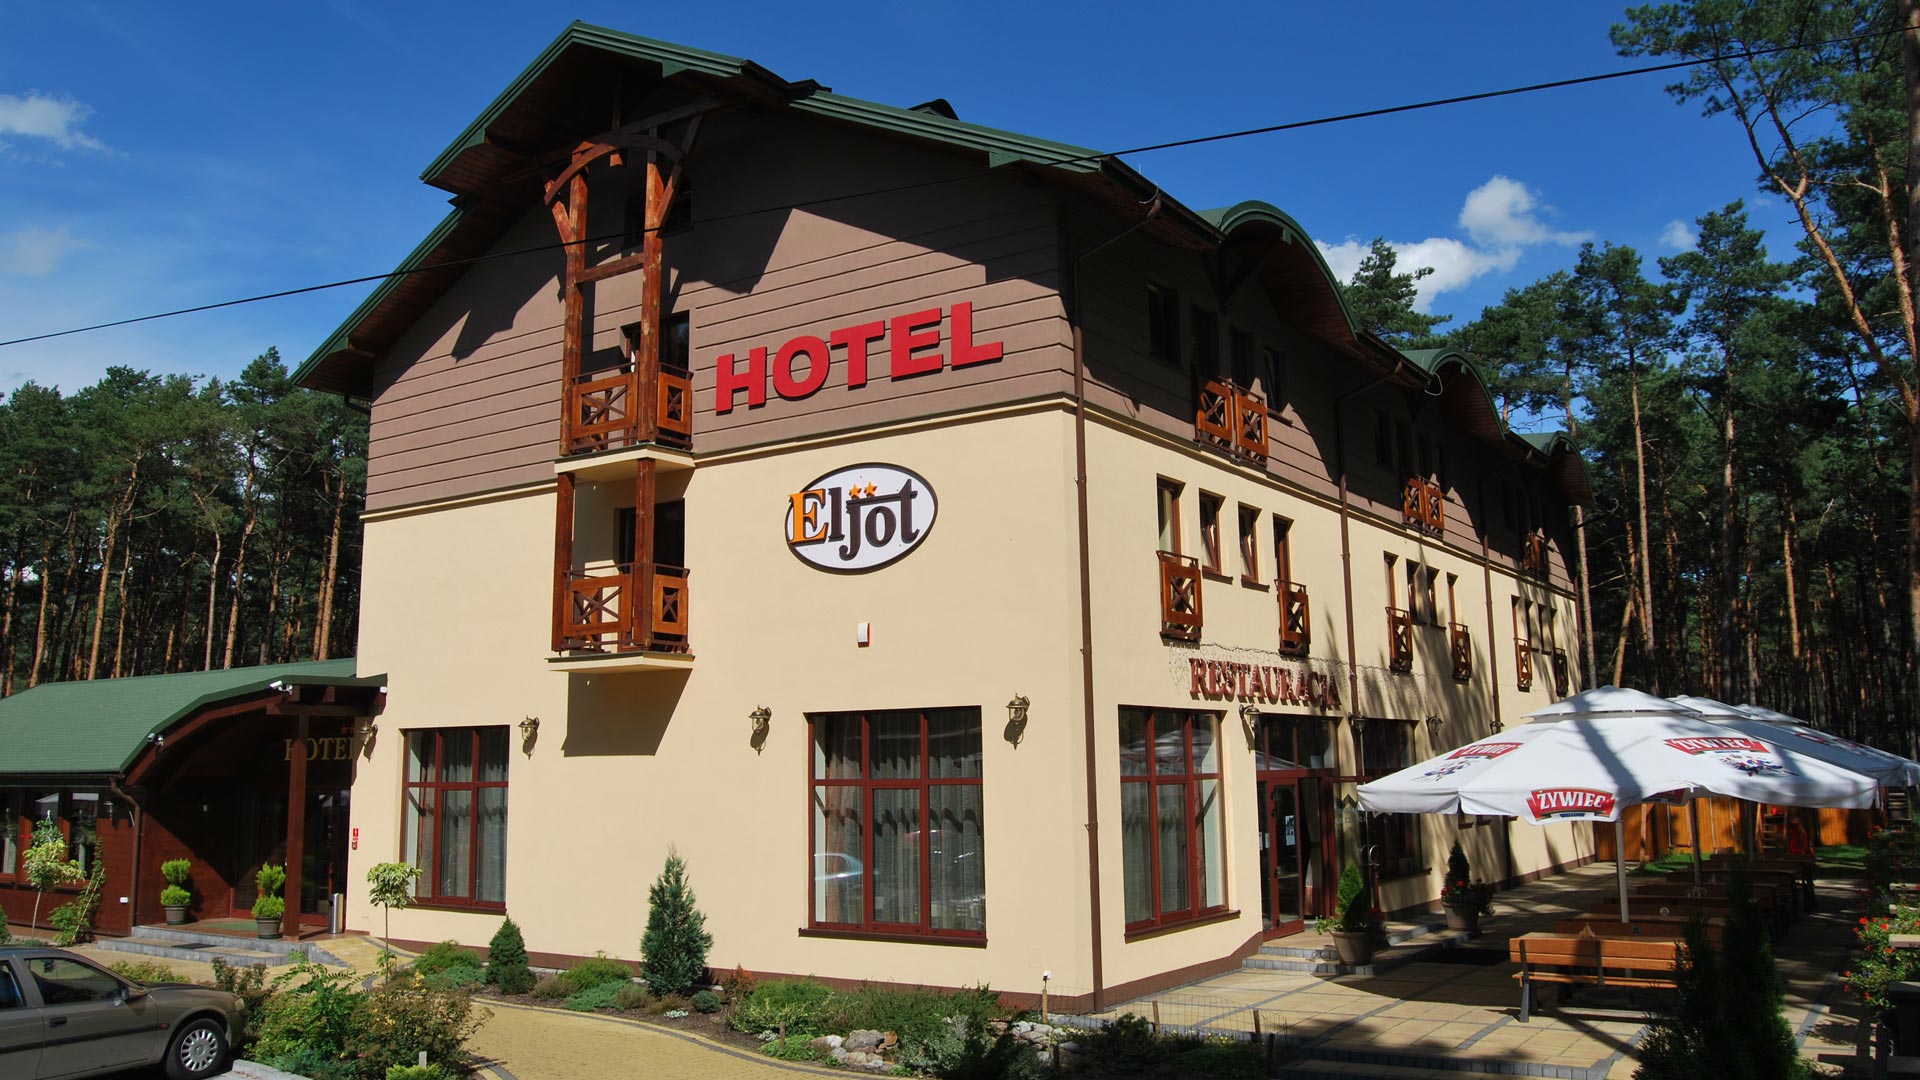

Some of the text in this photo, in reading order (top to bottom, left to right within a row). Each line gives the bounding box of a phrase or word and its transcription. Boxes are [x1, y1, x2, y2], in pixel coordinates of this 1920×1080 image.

[715, 301, 1004, 415] HOTEL
[1189, 658, 1341, 711] RESTAURACJA
[1537, 790, 1607, 810] ŻYWIEC
